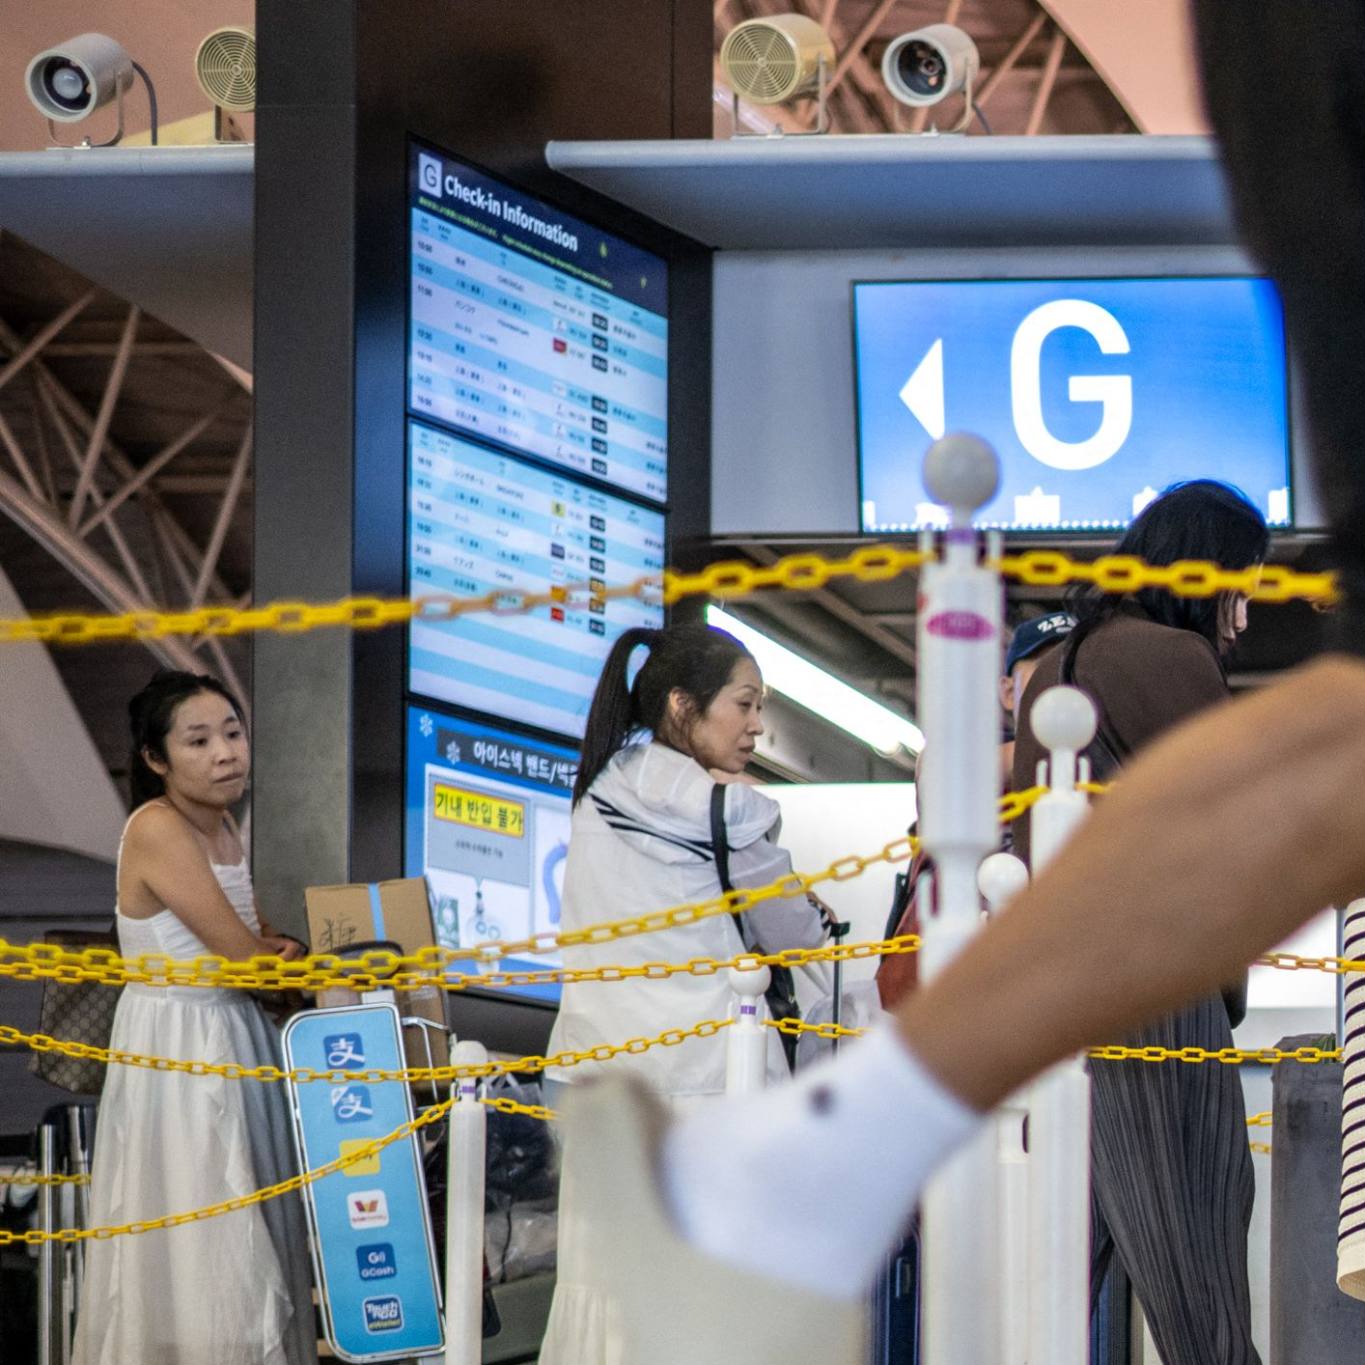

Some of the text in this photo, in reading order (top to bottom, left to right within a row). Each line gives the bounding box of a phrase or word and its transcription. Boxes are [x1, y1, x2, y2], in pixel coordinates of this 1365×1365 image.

[424, 163, 438, 188] G
[444, 174, 501, 217] Check-in
[502, 201, 579, 252] Information
[1010, 298, 1133, 471] G
[473, 740, 523, 775] 아이스넥
[436, 791, 523, 833] 기내 반입 불가
[361, 1266, 395, 1278] GCash
[366, 1300, 398, 1313] Touch
